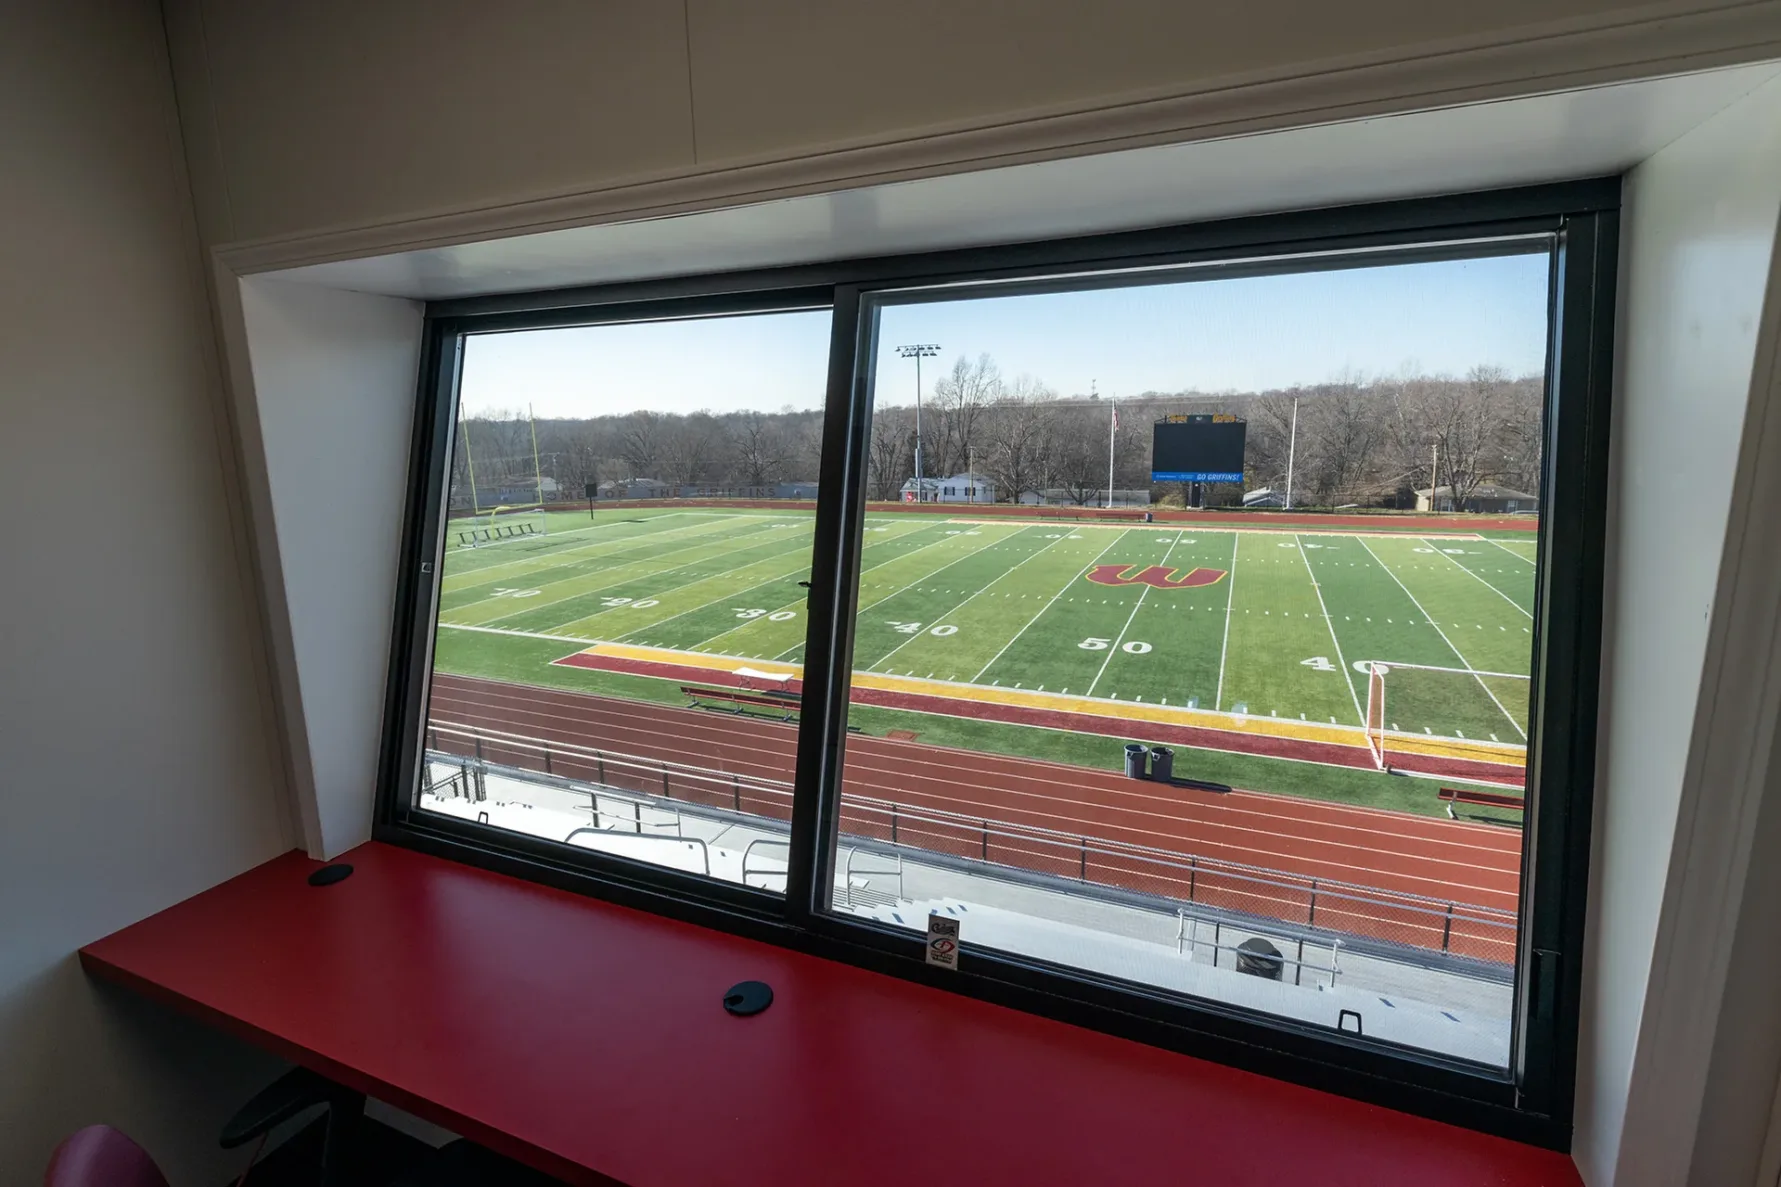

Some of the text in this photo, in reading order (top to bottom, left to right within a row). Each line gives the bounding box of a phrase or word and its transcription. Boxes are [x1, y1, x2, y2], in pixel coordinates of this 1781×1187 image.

[1196, 473, 1206, 481] GO
[532, 487, 776, 502] HOME OF THE GRIFFINS
[893, 622, 959, 636] 40
[1077, 637, 1153, 654] 50
[1300, 656, 1390, 675] 40
